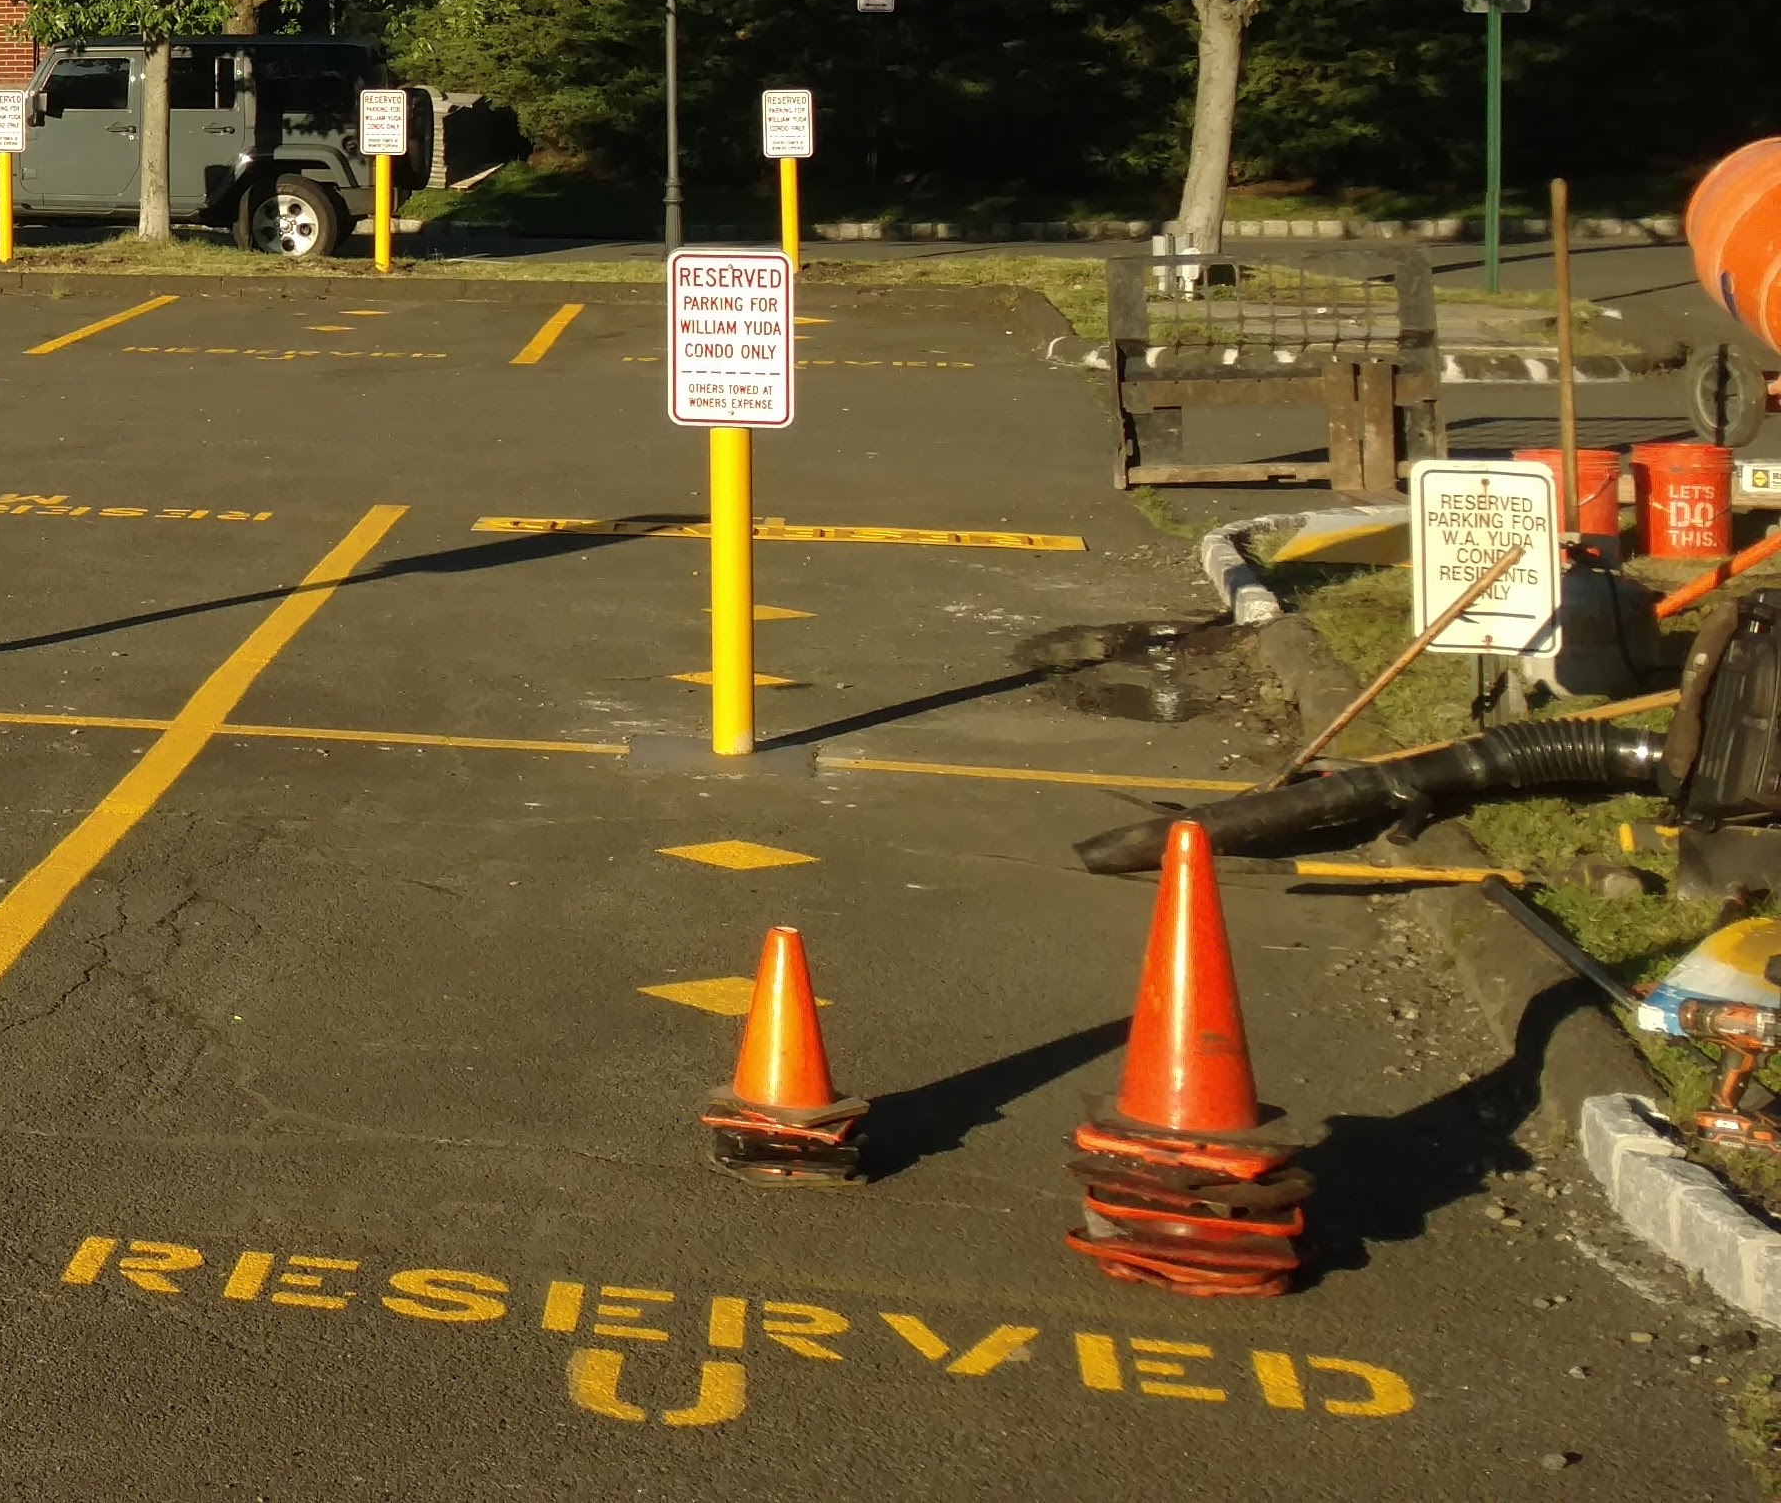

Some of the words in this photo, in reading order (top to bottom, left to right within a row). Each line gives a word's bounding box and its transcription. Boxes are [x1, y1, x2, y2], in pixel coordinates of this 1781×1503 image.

[364, 95, 402, 104] RESERVED
[767, 96, 807, 105] RESERVED
[679, 267, 782, 289] RESERVED
[683, 296, 744, 312] PARKING
[750, 296, 778, 312] FOR
[680, 320, 737, 336] WILLIAM
[743, 320, 782, 336] YUDA
[684, 343, 734, 360] CONDO
[740, 343, 777, 360] ONLY
[688, 383, 725, 395] OTHERS
[728, 383, 759, 395] TOWED
[762, 383, 773, 395] AT
[689, 398, 727, 409] WONERS
[731, 398, 773, 409] EXPENSE
[1668, 484, 1716, 500] LET'S
[1440, 494, 1534, 513] RESERVED
[1427, 511, 1504, 529] PARKING
[1511, 514, 1547, 532] FOR
[1668, 501, 1715, 528] DO
[1442, 530, 1480, 546] W.A.
[1487, 530, 1534, 549] YUDA
[1666, 529, 1718, 548] THIS.
[59, 1234, 1417, 1419] RESERVED
[567, 1347, 749, 1429] U
